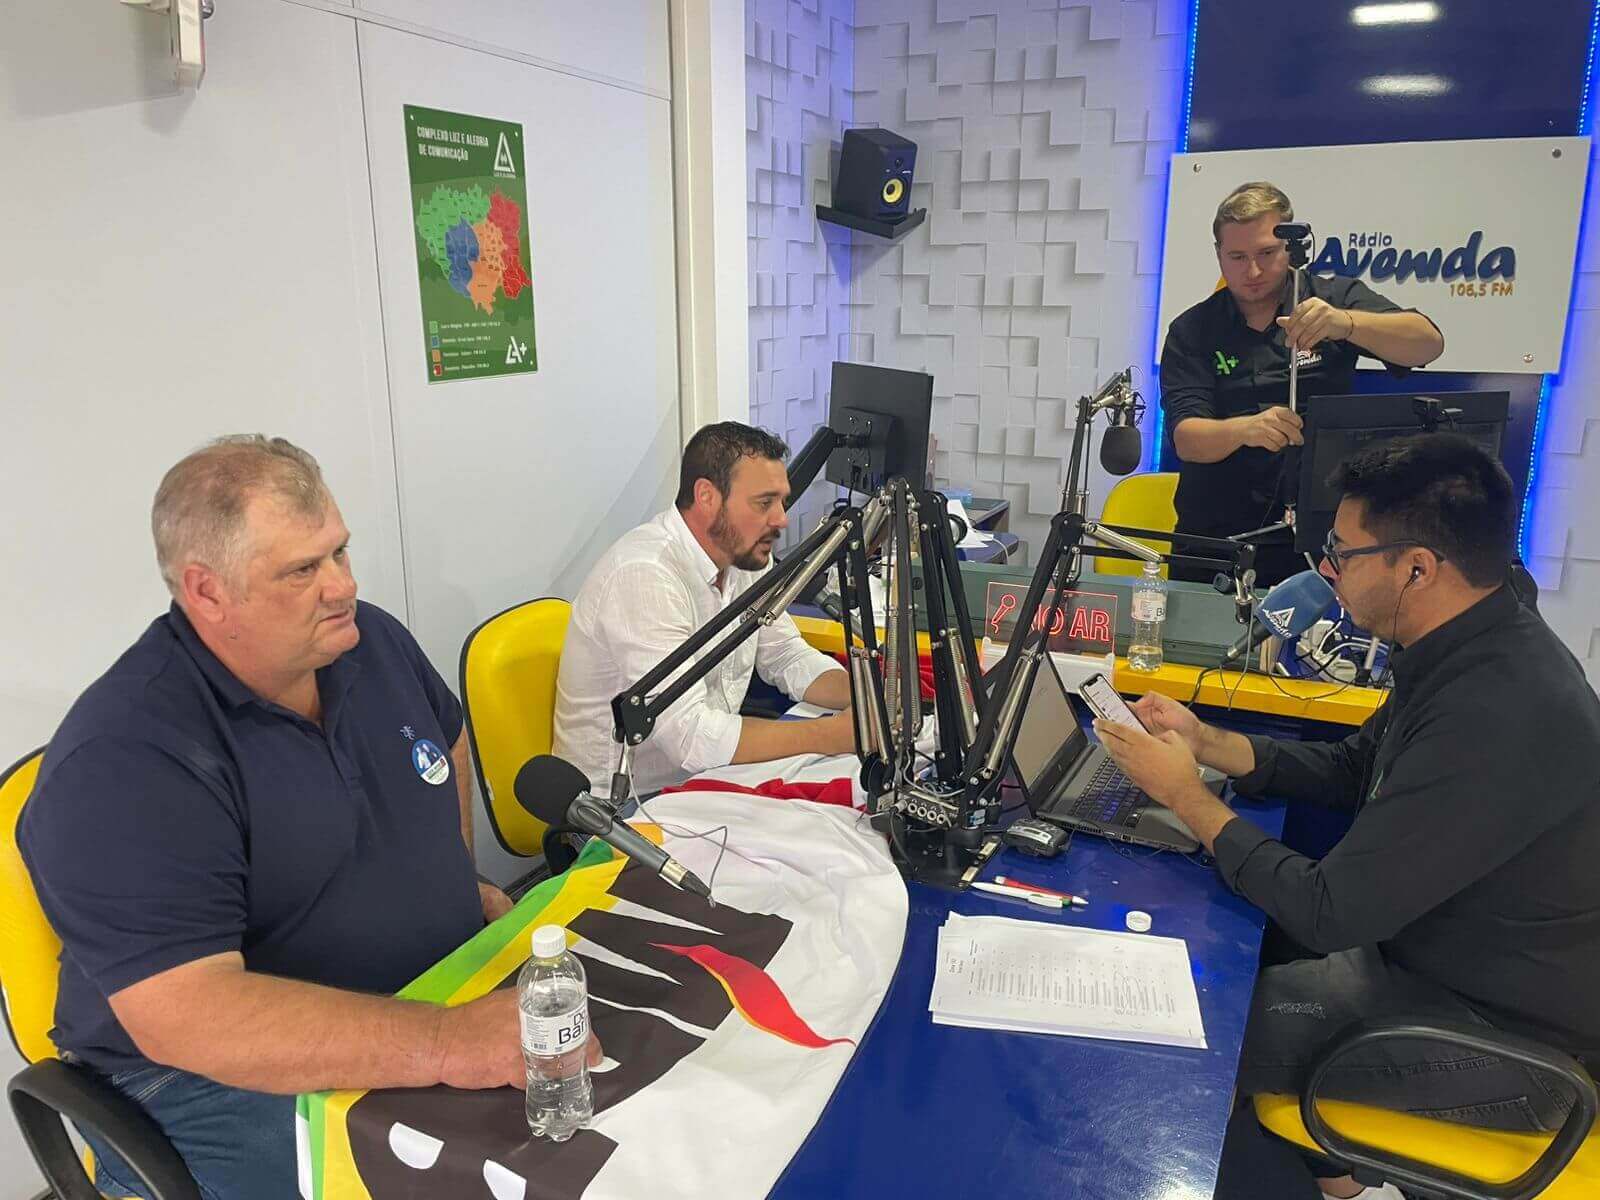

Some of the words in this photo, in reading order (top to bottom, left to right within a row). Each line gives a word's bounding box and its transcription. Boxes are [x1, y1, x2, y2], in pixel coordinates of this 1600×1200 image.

[417, 126, 449, 142] COMPLEXO
[449, 131, 462, 143] LUZ
[466, 134, 489, 147] ALEGRIA
[418, 143, 428, 155] DE
[427, 145, 469, 162] COMUNICAÇÃO
[1349, 231, 1393, 247] Rádio
[1306, 231, 1516, 283] Avenida
[1450, 284, 1487, 298] 106,5
[1491, 283, 1514, 297] FM
[1069, 607, 1110, 642] AR
